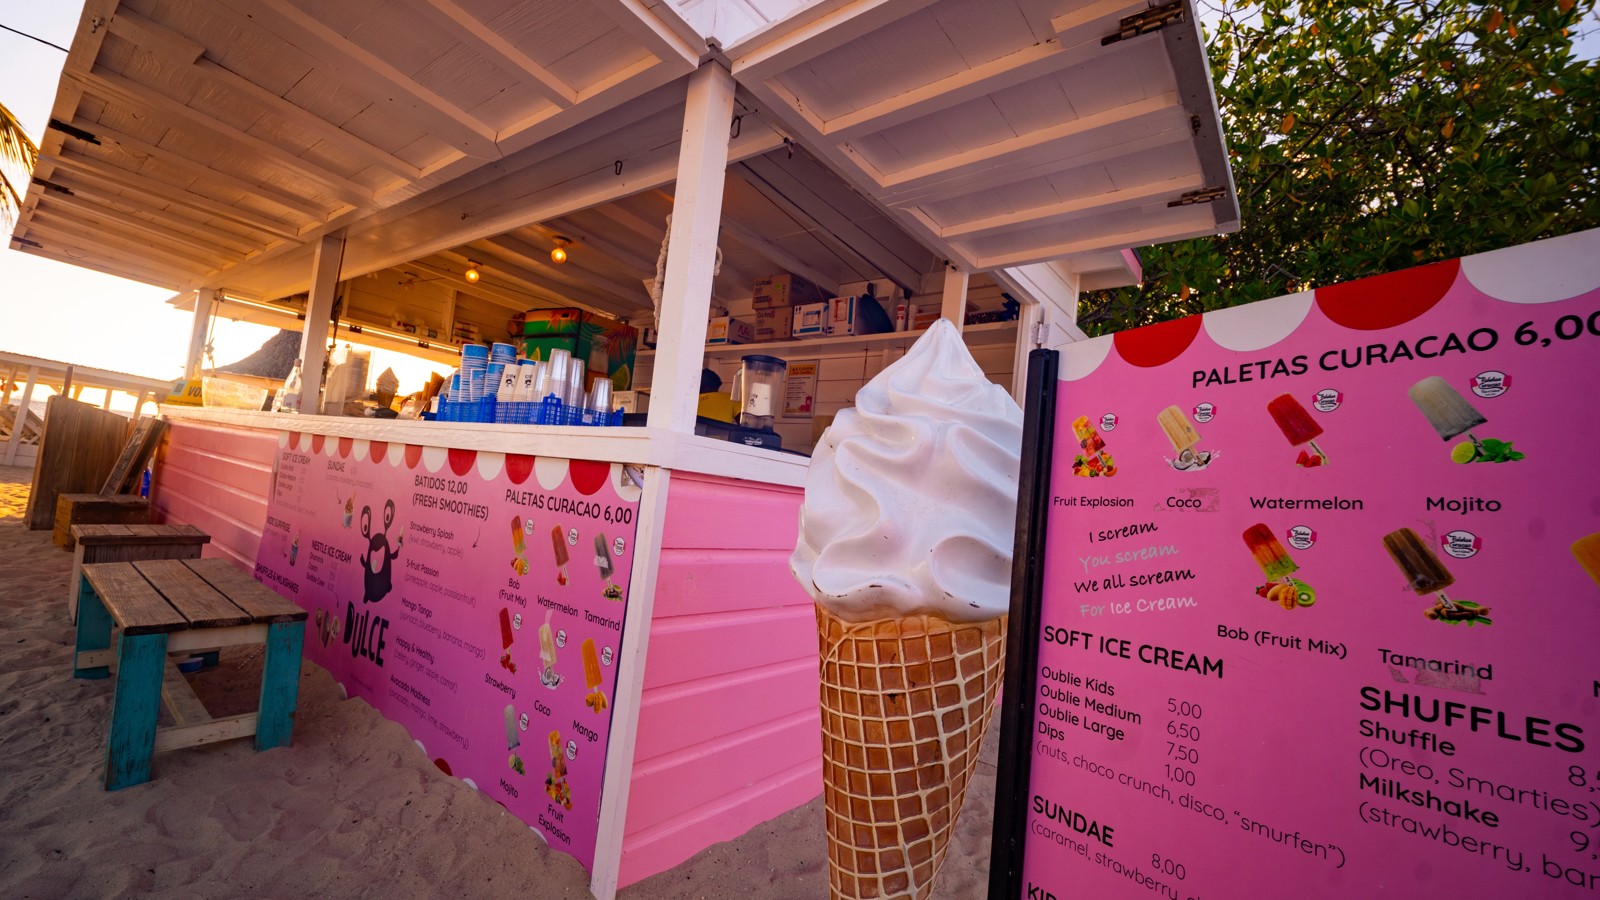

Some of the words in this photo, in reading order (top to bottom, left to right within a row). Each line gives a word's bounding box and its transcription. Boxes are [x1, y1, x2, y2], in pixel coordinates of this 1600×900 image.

[1192, 355, 1308, 388] PALETAS
[1319, 328, 1499, 371] CURACAO
[187, 385, 203, 398] VO
[327, 460, 345, 472] SUNDAE
[414, 474, 445, 491] BATIDOS
[447, 480, 467, 495] 12,00
[412, 492, 439, 508] (FRESH
[439, 498, 489, 521] SMOOTHIES)
[505, 489, 544, 509] PALETAS
[547, 496, 601, 519] CURACAO
[604, 505, 632, 525] 6,00
[1053, 496, 1077, 507] Fruit
[1080, 496, 1134, 509] Explosion
[1166, 496, 1202, 509] Coco
[1250, 496, 1363, 510] Watermelon
[1426, 496, 1502, 515] Mojito
[410, 521, 437, 538] Strawberry
[437, 528, 454, 540] Splash
[1089, 532, 1093, 543] I
[1098, 521, 1158, 542] scream
[335, 549, 352, 564] CREAM
[421, 563, 439, 577] Passion
[1078, 555, 1110, 573] You
[1115, 544, 1178, 564] scream
[508, 577, 520, 590] Bob
[1074, 581, 1098, 593] We
[1103, 573, 1125, 590] all
[1130, 567, 1195, 587] scream
[401, 597, 417, 612] Mango
[418, 603, 432, 619] Tango
[498, 589, 515, 602] (Fruit
[515, 595, 527, 608] Mix)
[537, 595, 578, 617] Watermelon
[1080, 604, 1104, 618] For
[1110, 601, 1132, 615] Ice
[1136, 596, 1198, 612] Cream
[584, 610, 620, 631] Tamarind
[343, 601, 389, 668] DULCE
[1217, 624, 1249, 641] Bob
[1254, 629, 1302, 651] (Fruit
[1308, 638, 1348, 660] Mix)
[395, 635, 411, 652] Happy
[416, 646, 435, 665] Healthy
[1043, 625, 1093, 650] SOFT
[1099, 636, 1131, 659] ICE
[1138, 645, 1223, 679] CREAM
[1378, 648, 1492, 681] Tamarind
[390, 674, 410, 693] Avocado
[409, 685, 431, 706] Madness
[485, 673, 516, 699] Strawberry
[1041, 666, 1081, 687] Oublie
[1085, 677, 1115, 696] Kids
[1167, 697, 1202, 719] 5,00
[534, 700, 551, 716] Coco
[1040, 684, 1080, 706] Oublie
[1084, 697, 1141, 725] Medium
[1167, 720, 1200, 742] 6,50
[1359, 686, 1585, 753] SHUFFLES
[572, 720, 598, 742] Mango
[1039, 703, 1079, 726] Oublie
[1083, 716, 1125, 741] Large
[1166, 741, 1199, 764] 7,50
[1038, 721, 1065, 741] Dips
[1164, 763, 1196, 787] 1,00
[1359, 719, 1456, 756] Shuffle
[1568, 765, 1600, 793] 8,
[500, 778, 518, 799] Mojito
[1036, 740, 1070, 765] (nuts,
[1073, 753, 1114, 780] choco
[1118, 772, 1174, 805] crunch,
[1178, 793, 1229, 825] disco,
[1359, 746, 1439, 785] (Oreo,
[1448, 768, 1600, 829] Smarties)
[547, 804, 564, 823] Fruit
[1360, 772, 1499, 828] Milkshake
[538, 813, 571, 845] Explosion
[1031, 818, 1091, 861] (caramel,
[1032, 795, 1114, 848] SUNDAE
[1151, 853, 1186, 881] 8,00
[1359, 801, 1531, 873] (strawberry,
